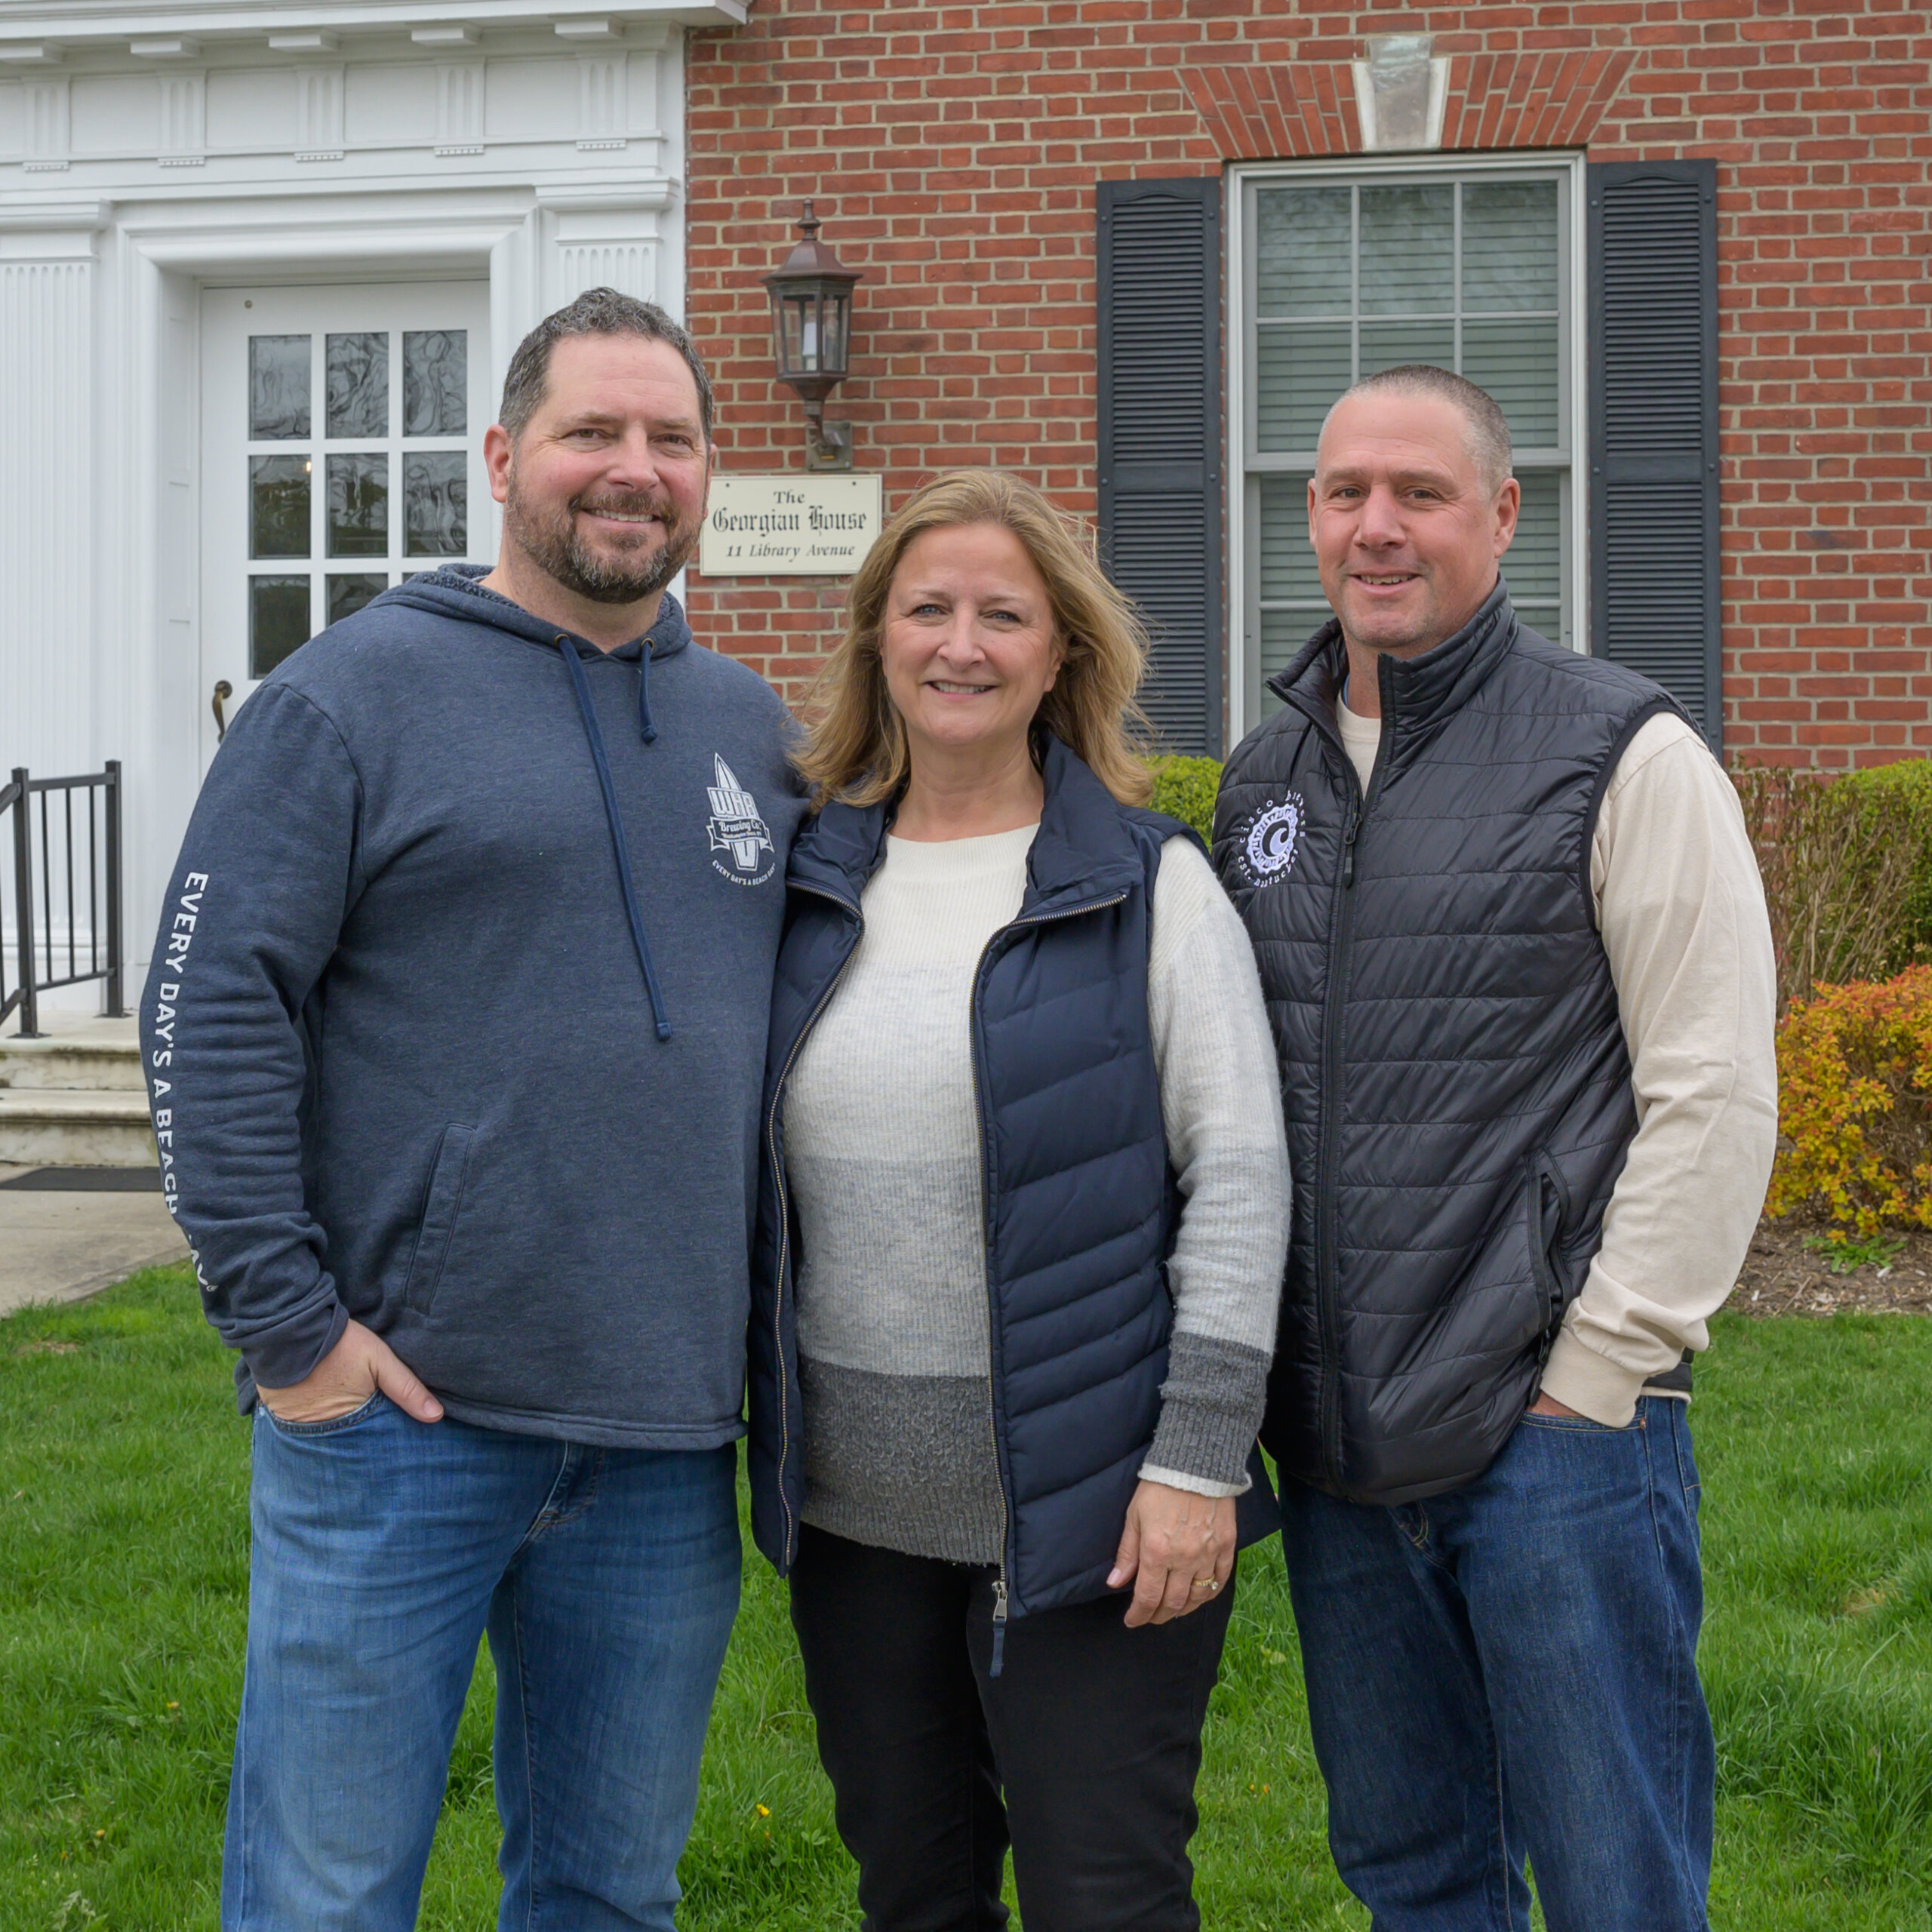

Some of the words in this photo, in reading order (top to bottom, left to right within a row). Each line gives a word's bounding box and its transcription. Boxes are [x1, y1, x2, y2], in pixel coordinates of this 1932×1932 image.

[774, 489, 805, 504] The
[712, 507, 799, 537] Georgian
[808, 505, 866, 536] House
[726, 545, 742, 557] 11
[749, 543, 801, 561] Library
[806, 544, 855, 556] Avenue
[718, 820, 751, 832] Brewing
[1240, 800, 1273, 843] cisco
[712, 860, 731, 878] EVERY
[752, 874, 768, 885] BEACH
[165, 872, 209, 974] EVERY
[152, 983, 180, 1067] DAY'S
[153, 1078, 172, 1099] A
[155, 1108, 178, 1214] BEACH
